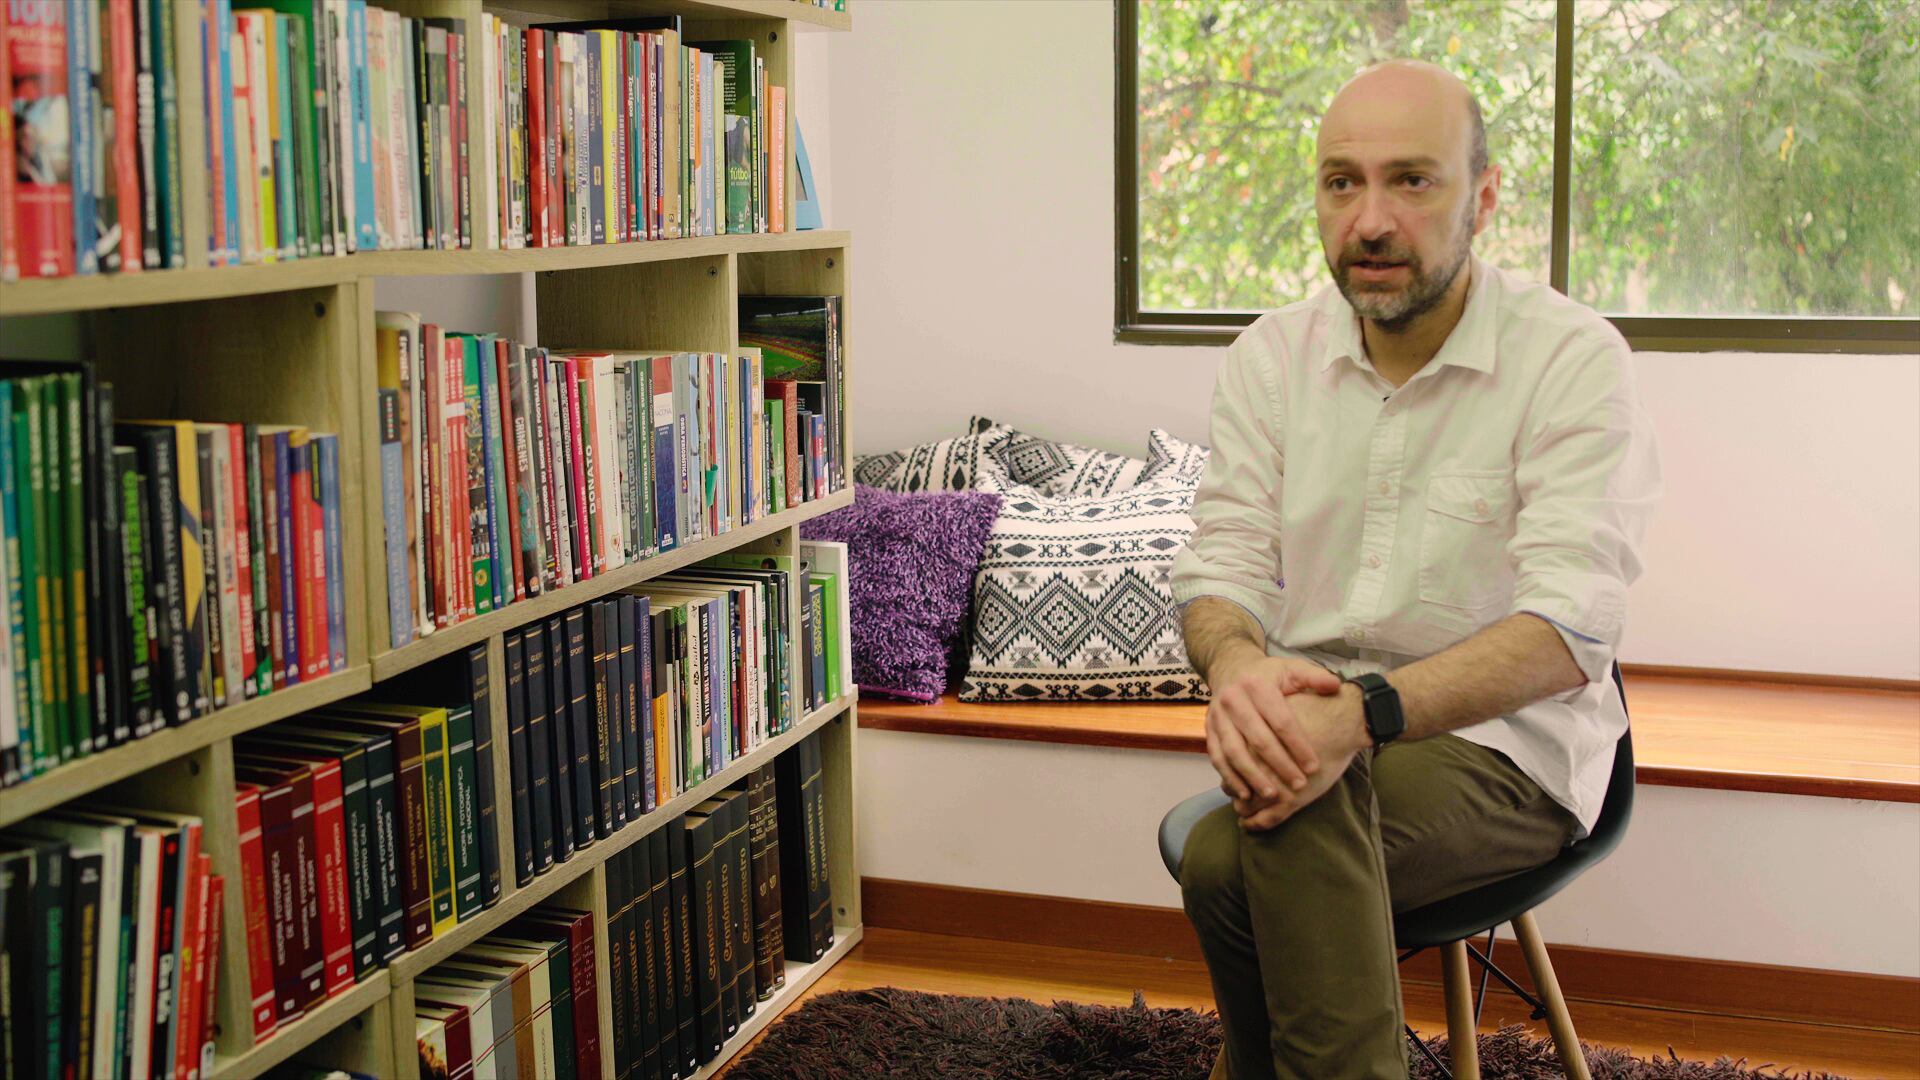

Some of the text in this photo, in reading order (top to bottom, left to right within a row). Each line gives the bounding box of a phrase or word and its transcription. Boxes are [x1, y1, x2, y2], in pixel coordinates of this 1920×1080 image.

[549, 136, 557, 177] CREER
[533, 381, 543, 423] FOOTBALL
[679, 416, 687, 436] OBRA
[542, 484, 551, 523] RECORDS
[552, 397, 571, 559] JUEGO LIMPIO
[585, 444, 596, 514] DONATO
[627, 451, 636, 485] CIRCO
[629, 486, 637, 517] GRAN
[159, 476, 175, 563] FOOTBALL
[167, 562, 179, 607] HALL
[596, 682, 605, 761] SELECCIONES
[807, 801, 818, 892] Cronómetro
[817, 794, 829, 883] Cronómetro
[703, 879, 716, 981] Cronómetro
[720, 862, 733, 962] Cronómetro
[738, 846, 751, 945] Cronómetro
[643, 917, 657, 1025] Cronómetro
[661, 905, 675, 1011] Cronómetro
[679, 893, 692, 998] Cronómetro
